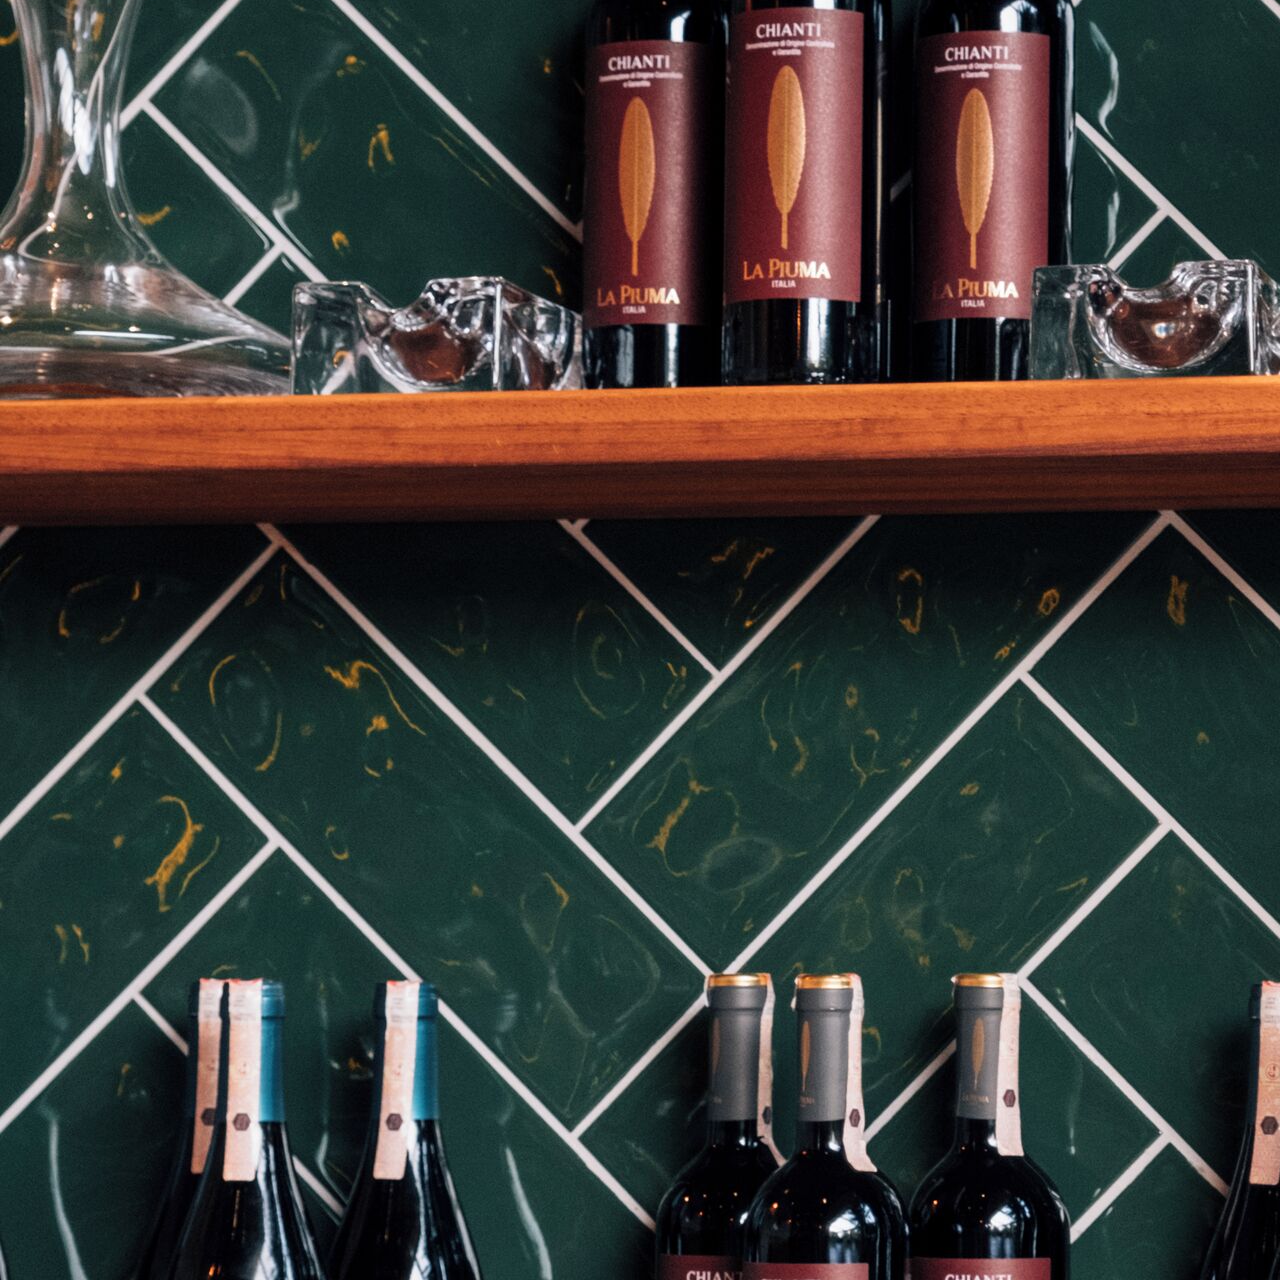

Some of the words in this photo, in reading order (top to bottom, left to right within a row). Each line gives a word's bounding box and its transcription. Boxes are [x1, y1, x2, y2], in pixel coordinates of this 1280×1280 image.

[756, 22, 822, 39] CHIANTI
[944, 45, 1009, 61] CHIANTI
[608, 54, 670, 71] CHIANTI
[743, 260, 764, 280] LA
[768, 257, 832, 279] PIUMA
[771, 279, 796, 288] ITALIA
[958, 278, 1019, 298] PIUMA
[597, 287, 616, 307] LA
[620, 284, 681, 305] PIUMA
